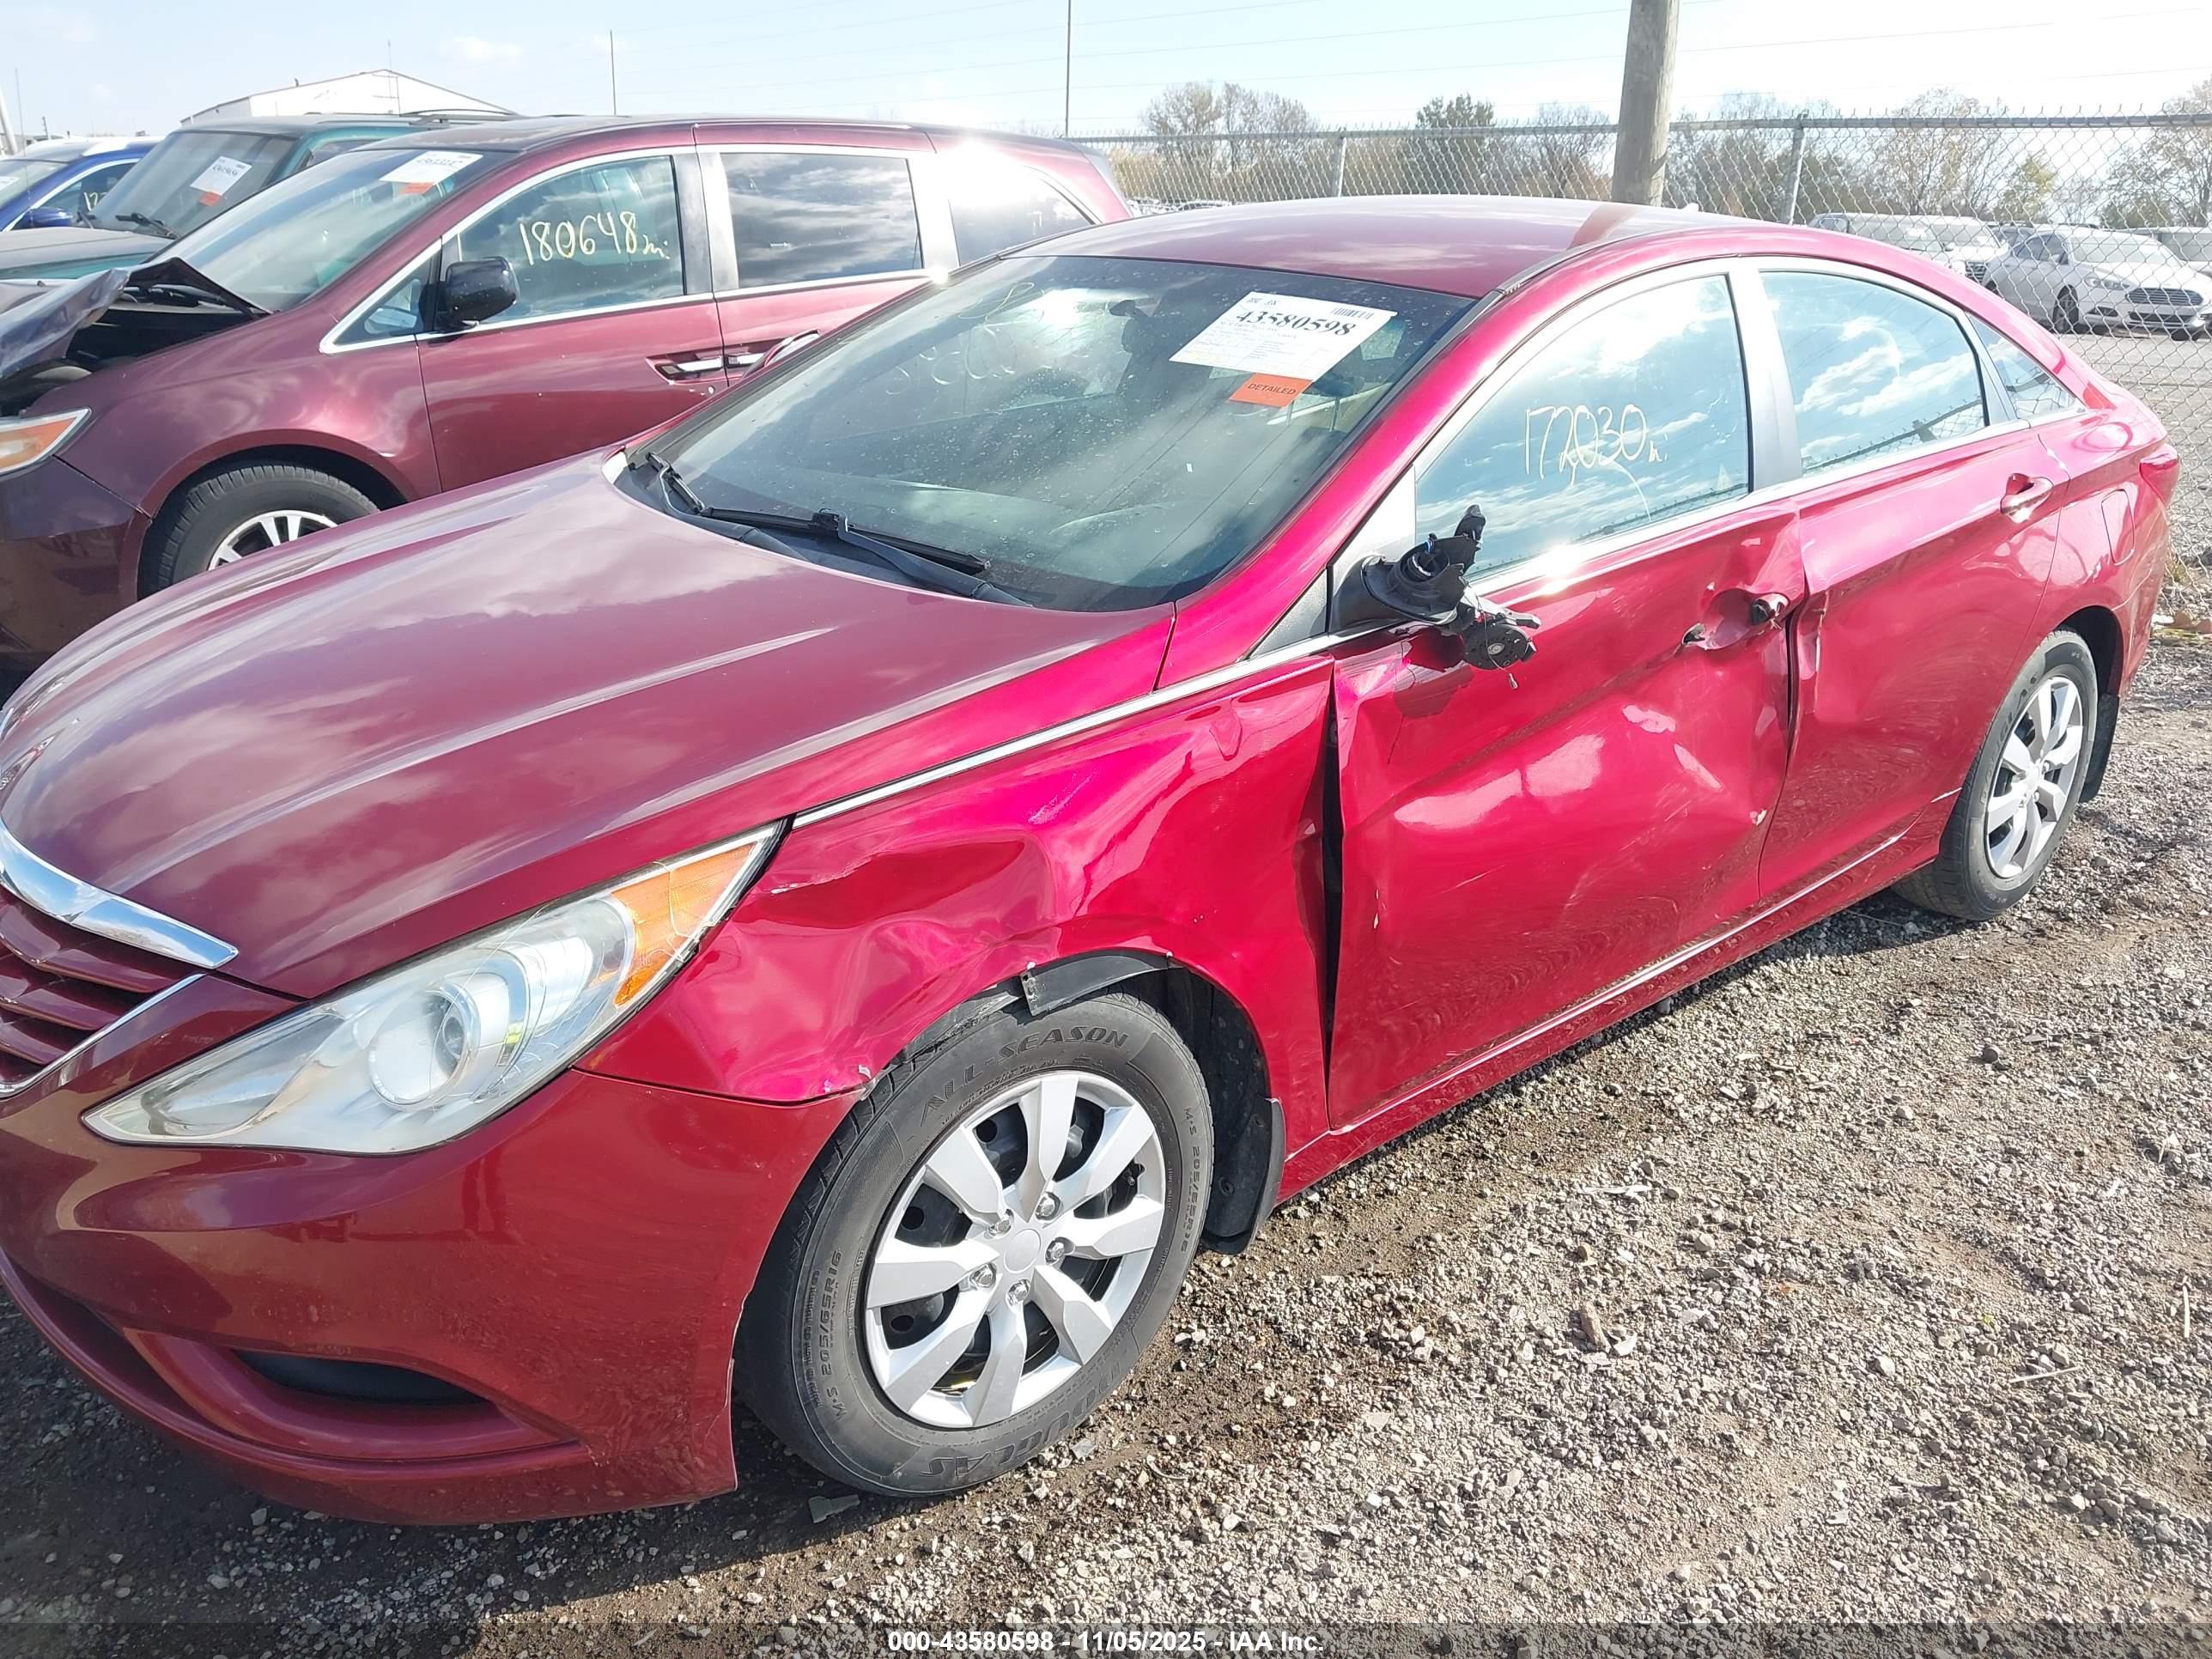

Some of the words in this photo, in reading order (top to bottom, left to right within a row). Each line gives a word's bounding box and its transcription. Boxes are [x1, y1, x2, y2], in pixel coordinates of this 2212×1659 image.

[520, 211, 637, 265] 180648
[1236, 311, 1357, 336] 43580598
[1247, 382, 1297, 396] DETAILED
[818, 1249, 842, 1376] 205/65R16
